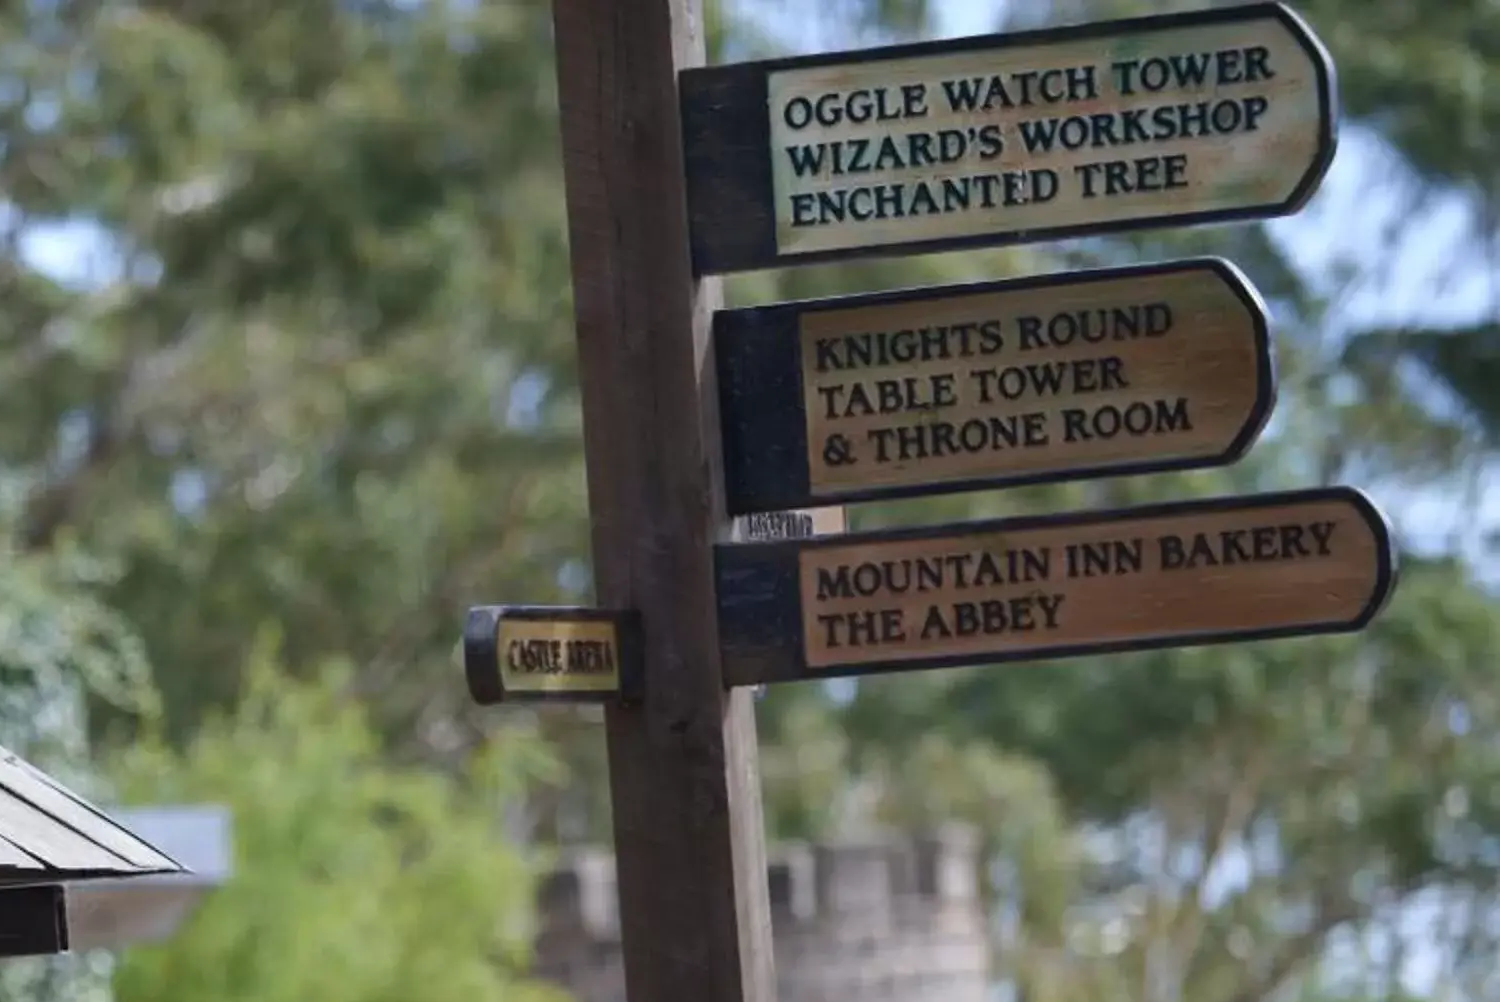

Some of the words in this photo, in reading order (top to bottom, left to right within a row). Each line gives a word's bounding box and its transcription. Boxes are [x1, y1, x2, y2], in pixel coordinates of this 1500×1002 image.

[783, 84, 929, 131] OGGLE
[941, 66, 1098, 115] WATCH
[1111, 45, 1276, 96] TOWER
[786, 126, 1004, 178] WIZARD'S
[1020, 97, 1270, 153] WORKSHOP
[789, 169, 1060, 228] ENCHANTED
[1074, 154, 1190, 198] TREE
[814, 320, 1005, 373] KNIGHTS
[1018, 302, 1175, 351] ROUND
[818, 376, 958, 421] TABLE
[970, 356, 1130, 404] TOWER
[821, 434, 858, 468] &
[867, 411, 1049, 462] THRONE
[1063, 398, 1193, 441] ROOM
[815, 547, 1052, 602] MOUNTAIN
[1066, 539, 1145, 580] INN
[1158, 520, 1339, 569] BAKERY
[817, 610, 908, 649] THE
[919, 593, 1067, 638] ABBEY
